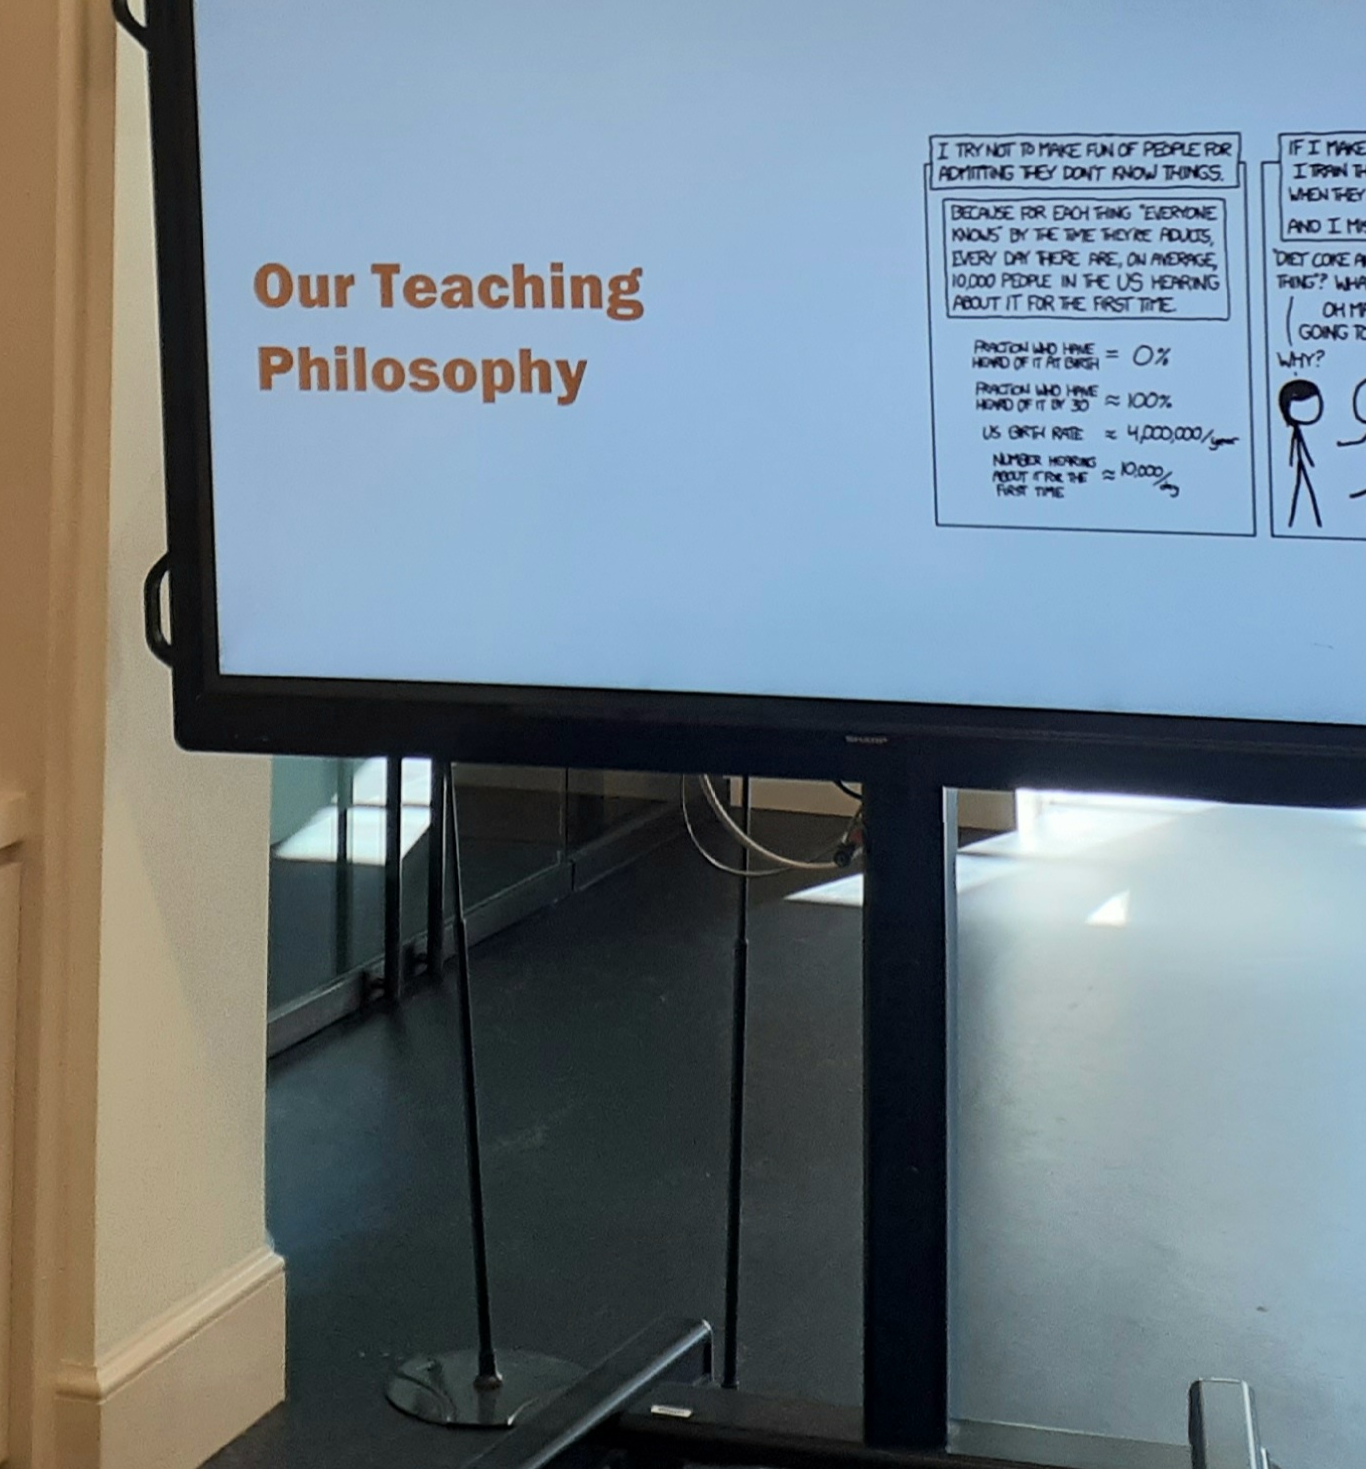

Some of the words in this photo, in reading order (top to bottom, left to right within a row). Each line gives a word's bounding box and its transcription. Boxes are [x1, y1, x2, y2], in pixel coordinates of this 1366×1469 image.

[937, 143, 949, 159] I
[956, 142, 983, 158] TRY
[986, 142, 1015, 157] NOT
[1020, 142, 1035, 157] TO
[1039, 142, 1081, 157] MAKE
[1087, 142, 1114, 157] FUN
[1118, 142, 1136, 157] OF
[1143, 140, 1200, 157] PEOPLE
[1205, 142, 1232, 157] FOR
[1289, 140, 1304, 156] IF
[1308, 140, 1320, 155] I
[939, 165, 1014, 181] ADMITTING
[1019, 165, 1056, 181] THEY
[1063, 165, 1105, 181] DON'T
[1112, 164, 1158, 181] KNOW
[1163, 164, 1224, 181] THINGS.
[1294, 163, 1307, 179] I
[1312, 163, 1347, 178] TRAIN
[1289, 187, 1328, 202] WHEN
[1332, 187, 1366, 202] THEY
[1288, 219, 1321, 234] AND
[1328, 218, 1341, 234] I
[254, 263, 354, 308] Our
[371, 262, 644, 321] Teaching
[1277, 349, 1325, 368] WHY?
[258, 347, 588, 406] Philosophy
